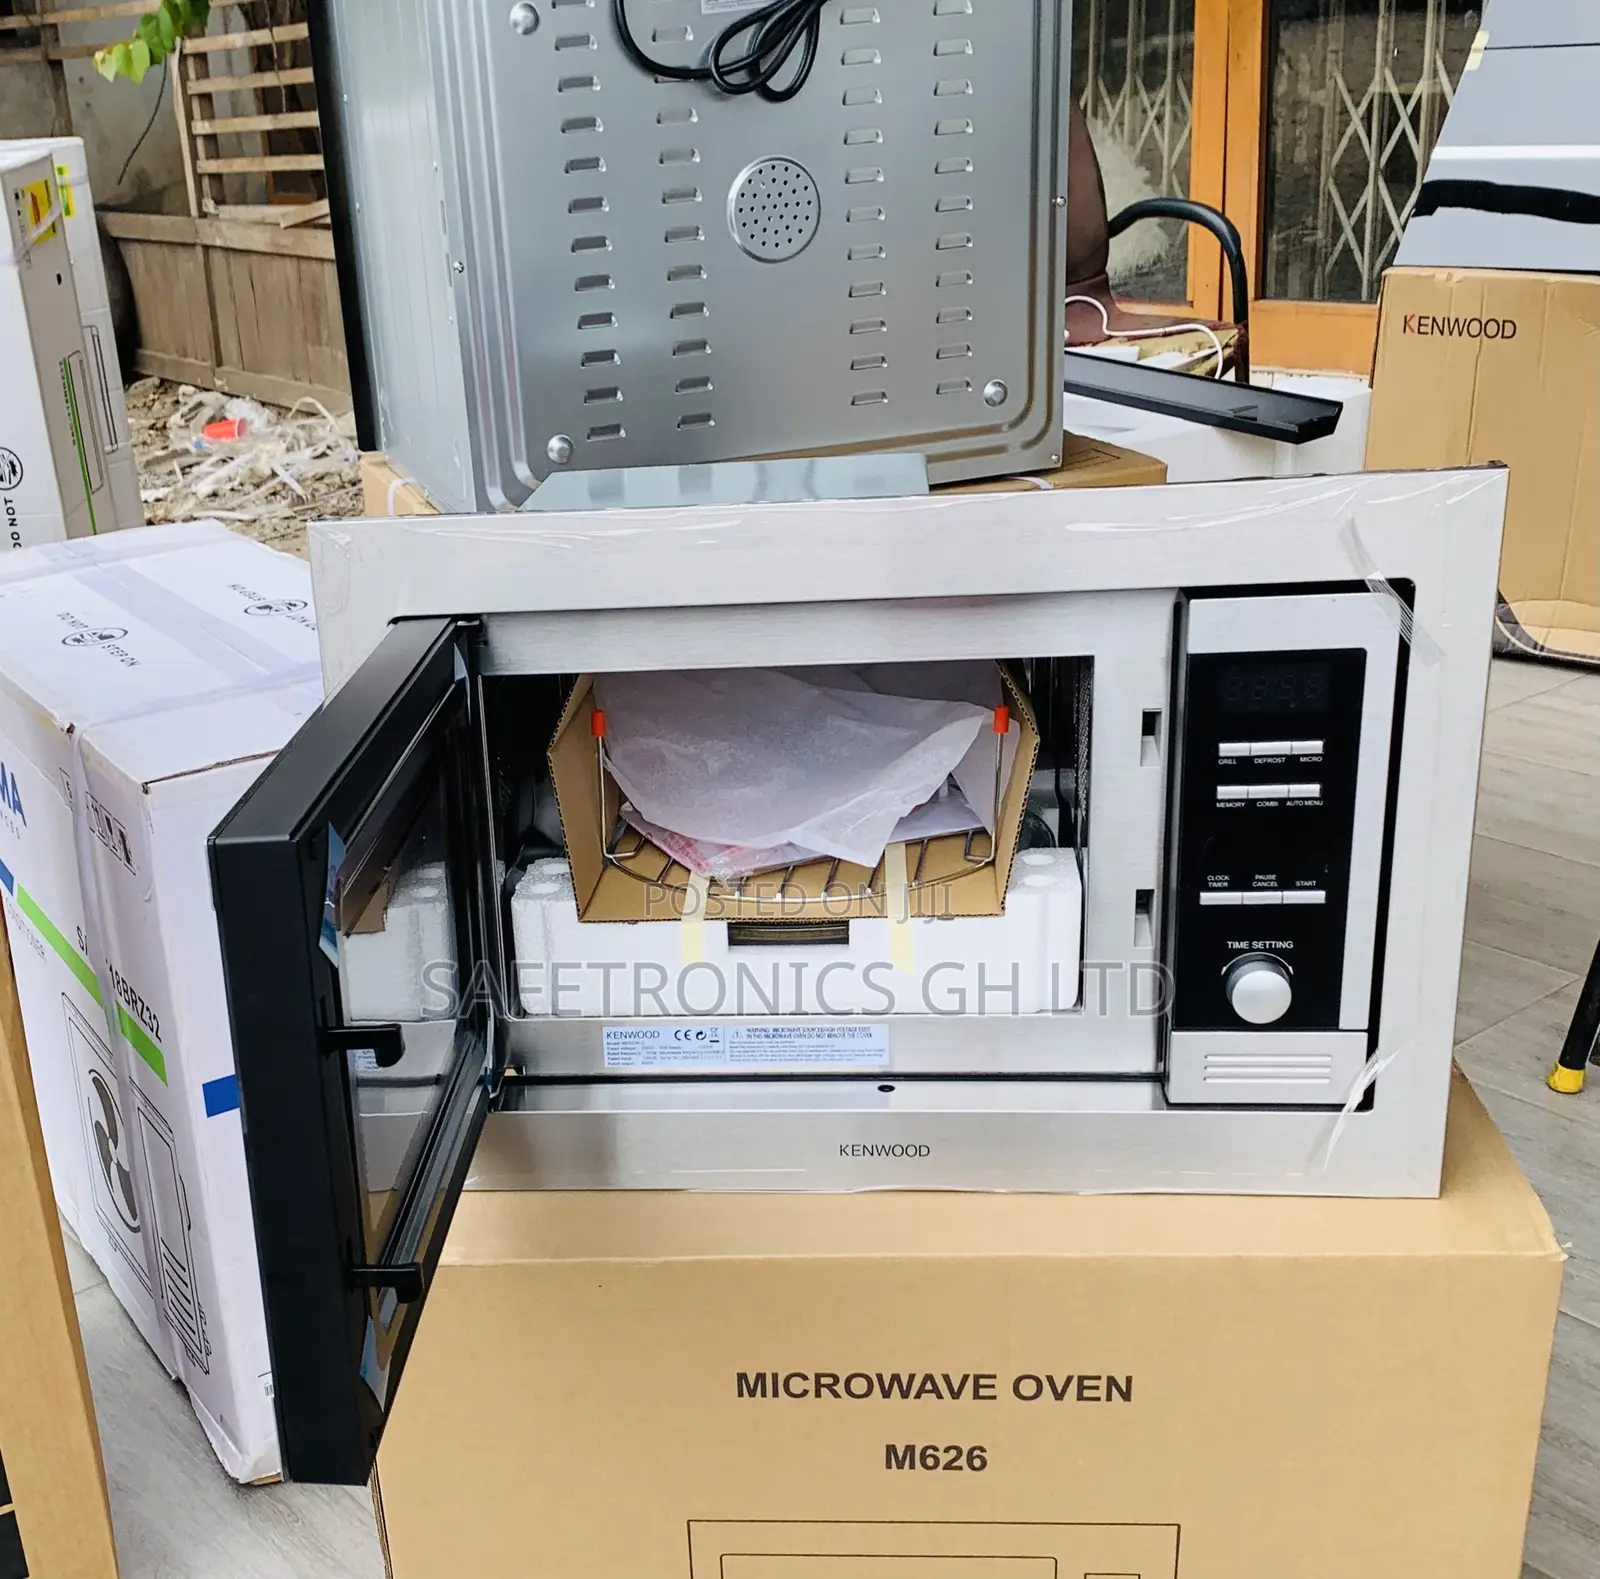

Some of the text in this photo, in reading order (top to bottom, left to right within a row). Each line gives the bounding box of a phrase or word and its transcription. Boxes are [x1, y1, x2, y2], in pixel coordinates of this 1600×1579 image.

[1402, 313, 1517, 339] KENWOOD
[4, 496, 18, 527] NOT
[1254, 756, 1287, 764] DEFROST
[1300, 755, 1323, 763] MICRO
[1216, 799, 1324, 809] MEMORY COMBI AUTO MENU
[1207, 874, 1230, 882] CLOCK
[1255, 873, 1277, 881] PAUSE
[1252, 880, 1279, 888] CANCEL
[1226, 940, 1294, 949] TIME SETTING
[606, 1030, 660, 1039] KENWOOD
[839, 1143, 931, 1158] KENWOOD
[736, 1372, 1134, 1402] MICROWAVE OVEN
[885, 1444, 989, 1472] M626
